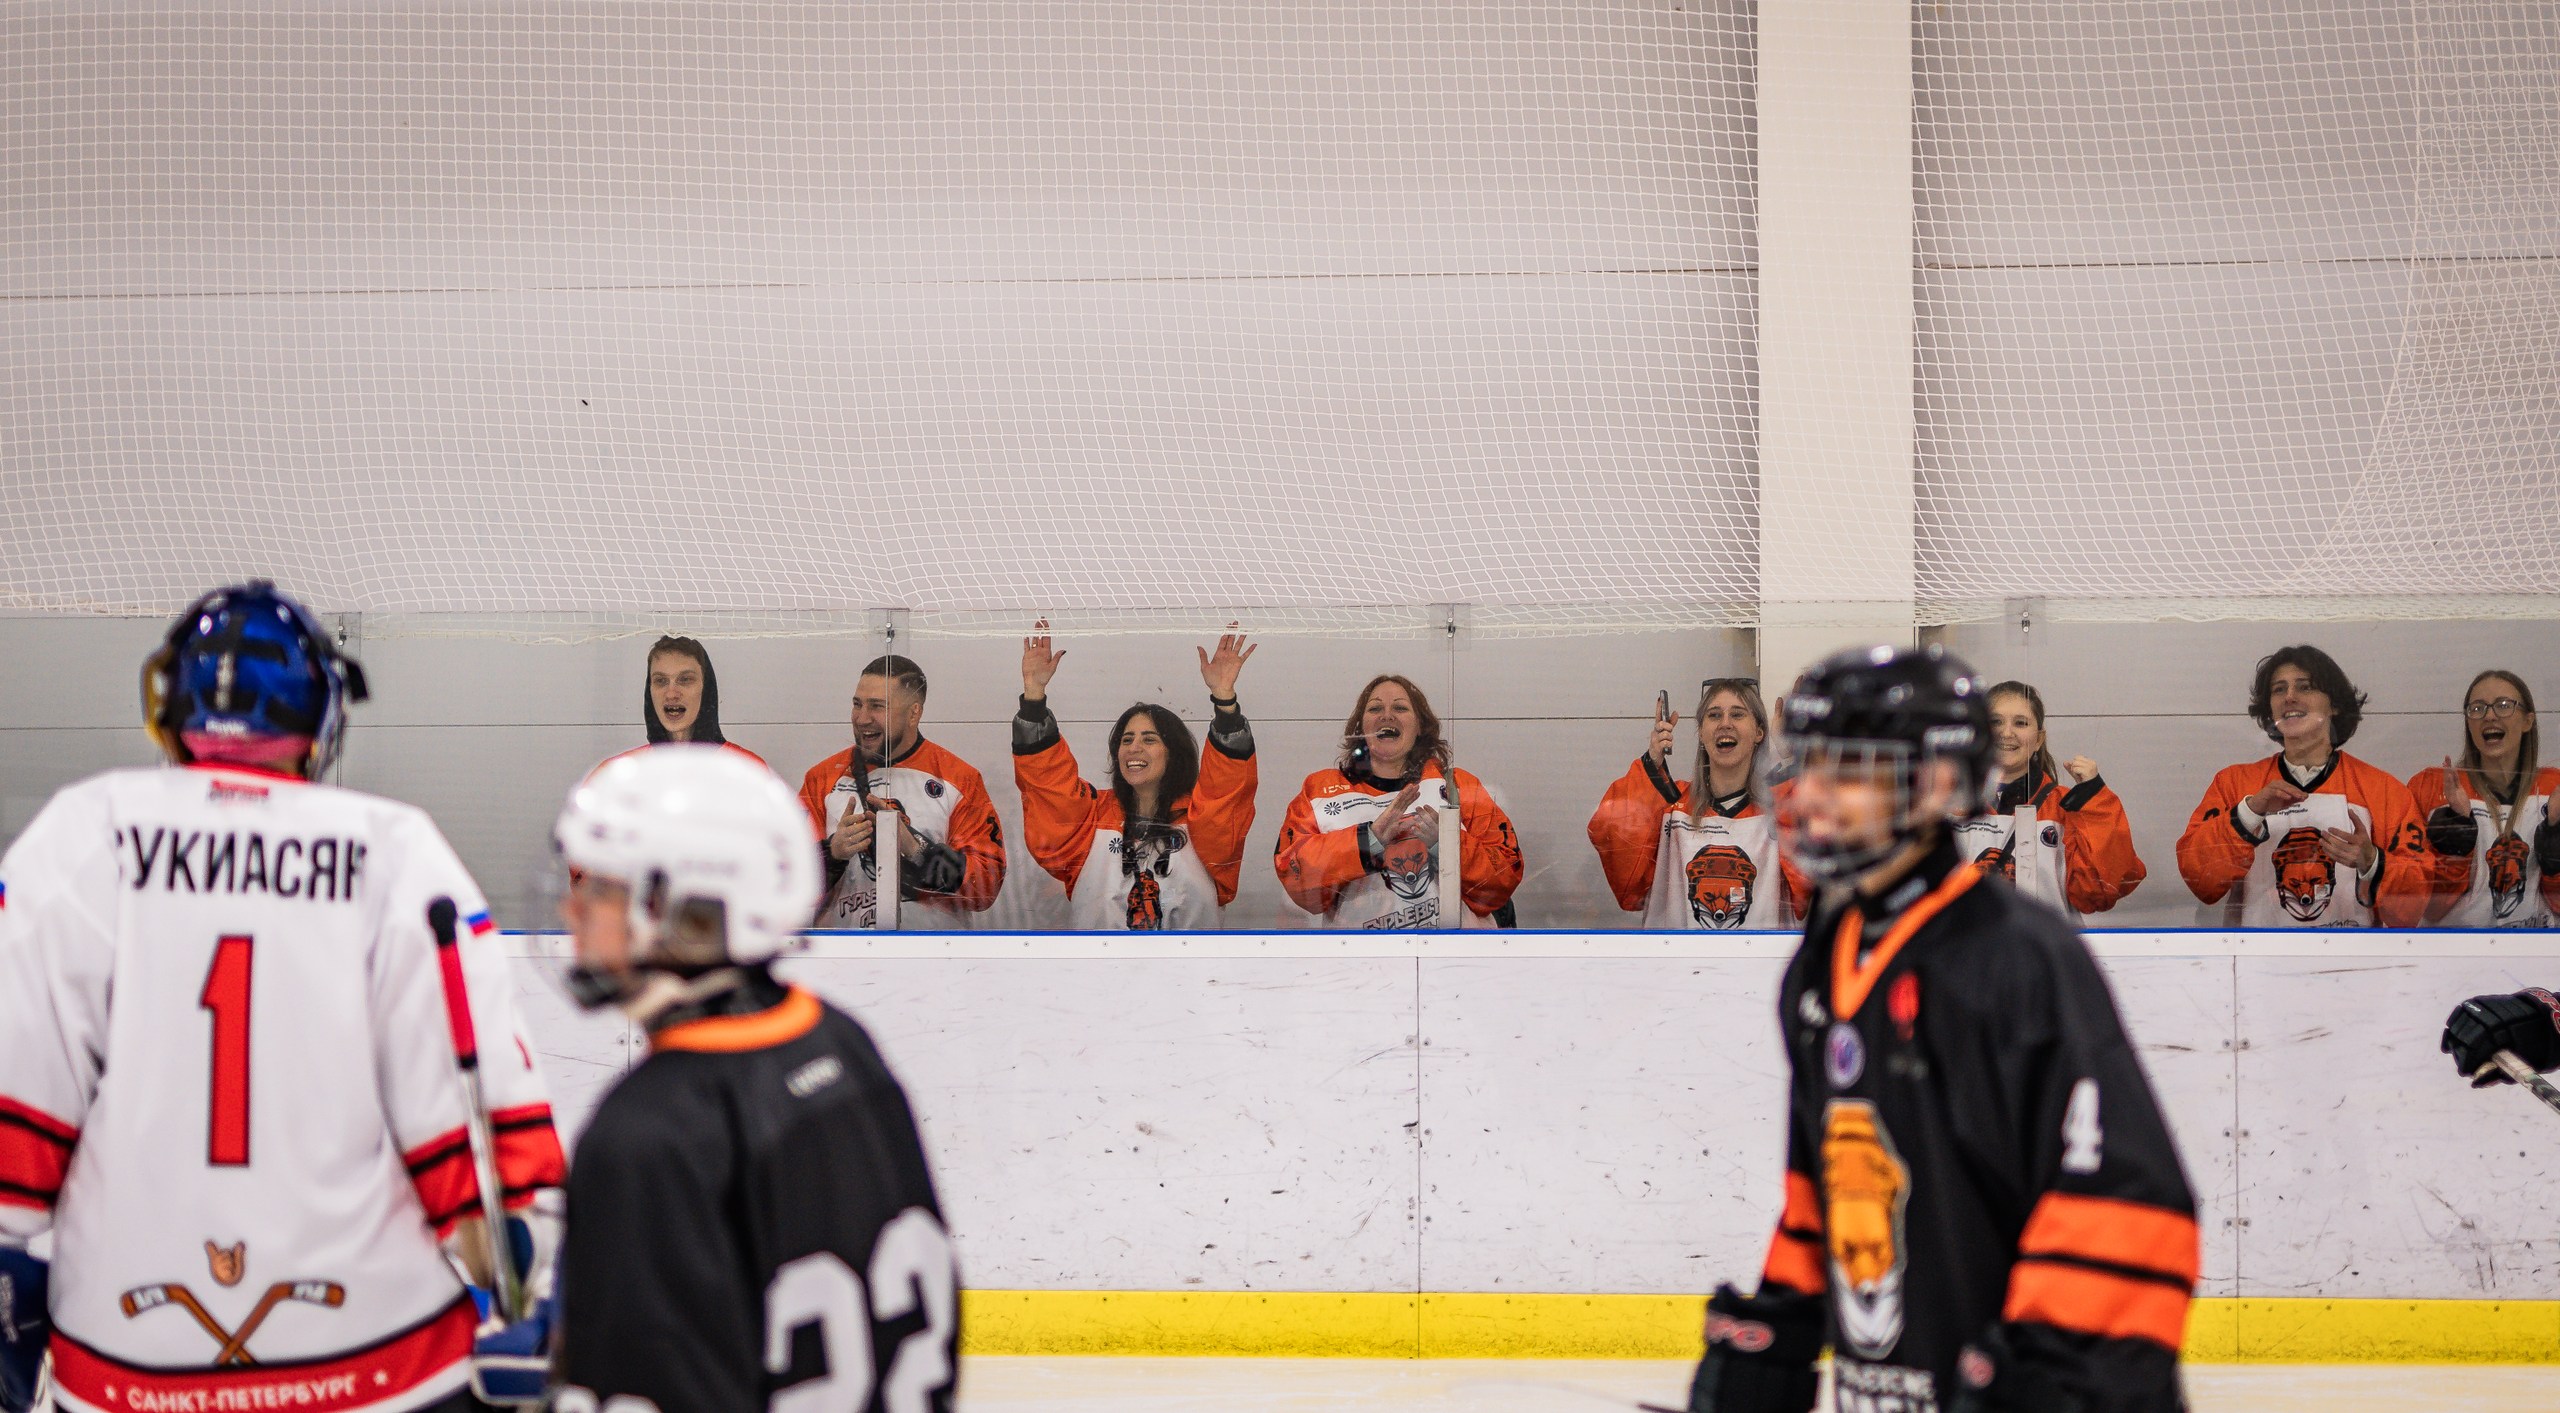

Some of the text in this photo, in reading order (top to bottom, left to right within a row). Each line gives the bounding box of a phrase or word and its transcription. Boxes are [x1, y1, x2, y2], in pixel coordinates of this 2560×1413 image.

[115, 826, 368, 901] УКИАСЯН
[199, 934, 253, 1167] 1
[2061, 1077, 2103, 1172] 4
[126, 1374, 358, 1413] САНКТ-ПЕТЕРБУРГ
